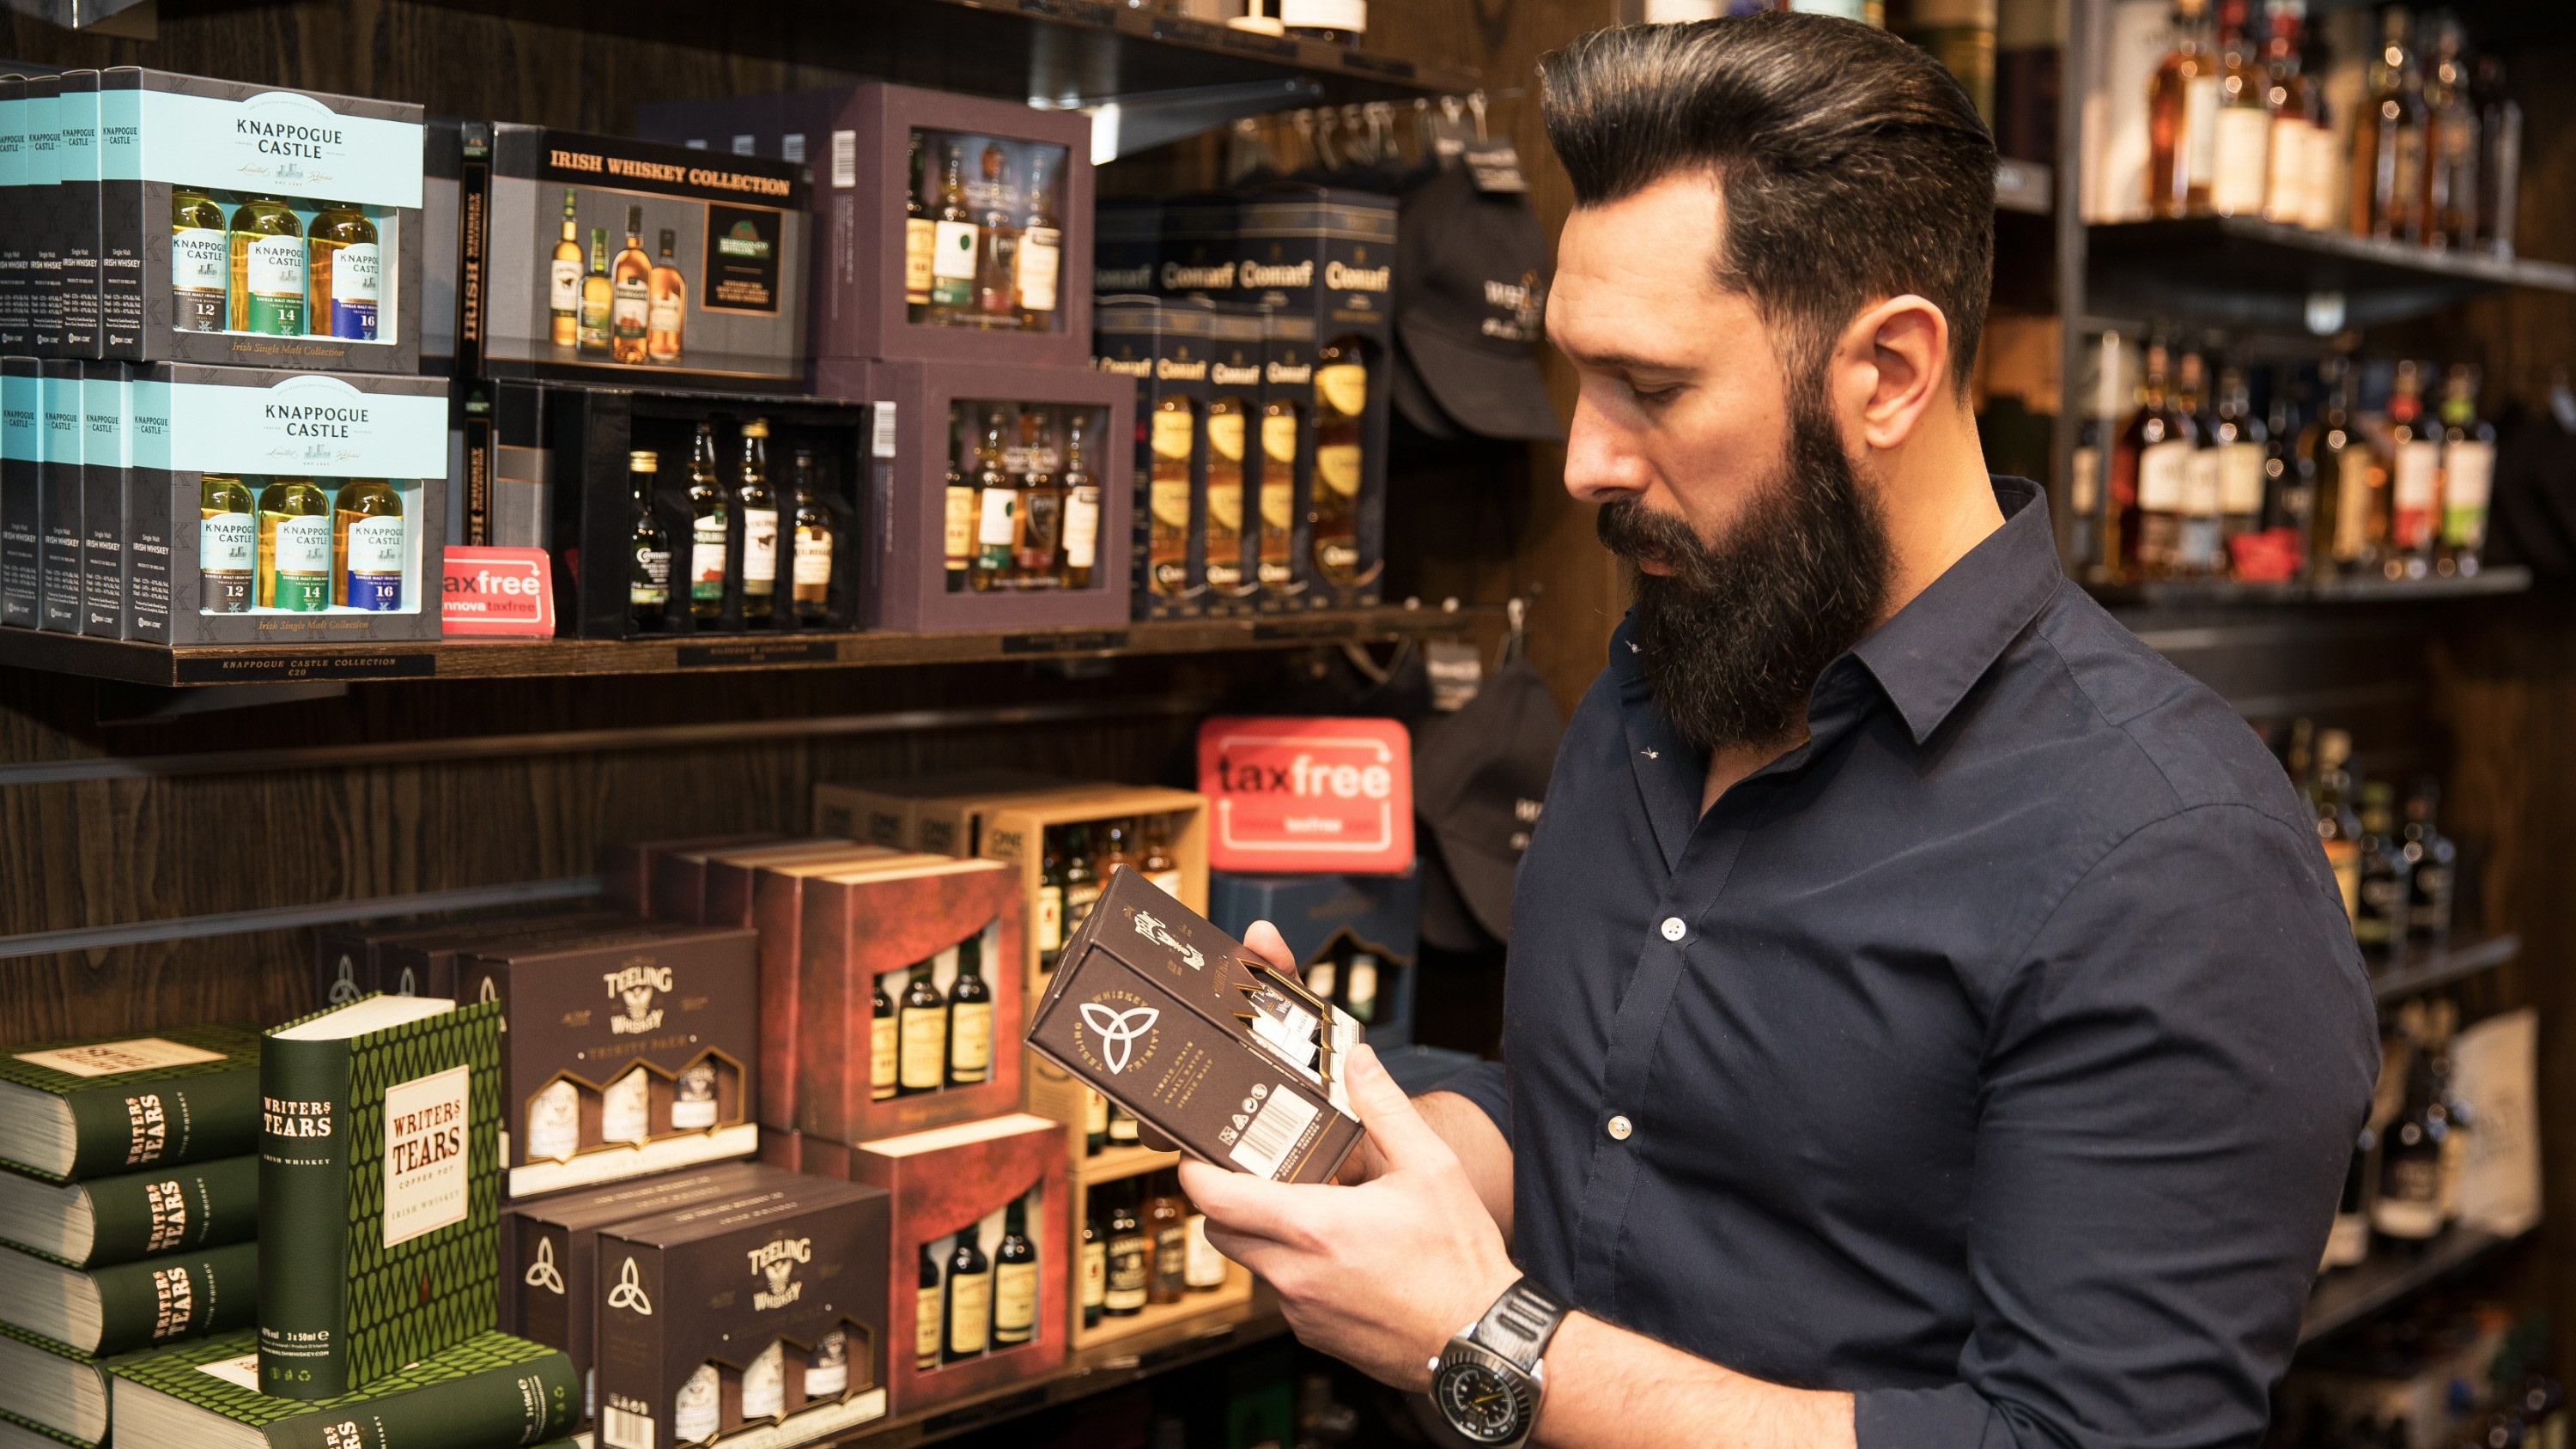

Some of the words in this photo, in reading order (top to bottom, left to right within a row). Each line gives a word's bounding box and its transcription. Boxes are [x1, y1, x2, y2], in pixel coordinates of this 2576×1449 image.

[29, 133, 60, 142] KNAPPOGUE
[63, 129, 94, 137] KNAPPOGUE
[103, 127, 137, 136] KNAPPOGUE
[237, 118, 343, 144] KNAPPOGUE
[69, 137, 88, 146] CASTLE
[109, 136, 131, 144] CASTLE
[258, 139, 322, 160] CASTLE
[550, 149, 604, 173] IRISH
[606, 157, 688, 184] WHISKEY
[689, 167, 791, 197] COLLECTION
[466, 192, 476, 257] WHISKEY
[112, 248, 122, 257] Single
[187, 250, 222, 261] CASTLE
[8, 261, 28, 270] WHISKEY
[30, 260, 43, 269] IRISH
[43, 261, 62, 270] WHISKE
[63, 258, 76, 266] IRISH
[118, 259, 140, 268] WHISKEY
[269, 257, 301, 267] CASTLE
[353, 264, 378, 273] CASTL
[464, 260, 479, 341] IRISH
[196, 303, 215, 316] 12
[278, 309, 295, 320] 14
[361, 315, 375, 326] 16
[232, 341, 252, 353] Irish
[254, 343, 279, 356] Single
[282, 345, 301, 355] Malt
[303, 345, 344, 357] Collection
[3, 409, 34, 420] KNAPPOGUE
[46, 412, 77, 422] KNAPPOGUE
[265, 404, 368, 422] KNAPPOGUE
[9, 419, 28, 427] CASTLE
[52, 421, 70, 430] CASTLE
[87, 415, 118, 425] KNAPPOGUE
[134, 415, 167, 427] KNAPPOGUE
[92, 423, 112, 433] CASTLE
[141, 425, 161, 434] CASTLE
[286, 422, 349, 439] CASTLE
[205, 523, 254, 535] KNAPPOGU
[15, 533, 36, 543] WHISKEY
[45, 535, 58, 544] IRISH
[58, 537, 79, 548] WHISKEY
[219, 534, 252, 543] CASTLE
[296, 536, 327, 545] CASTLE
[368, 536, 400, 545] CASTLE
[86, 539, 98, 548] IRISH
[99, 541, 120, 551] WHISKEY
[133, 542, 146, 551] IRISH
[146, 544, 169, 555] WHISKEY
[443, 570, 540, 596] axfree
[226, 585, 244, 597] 12
[303, 586, 320, 597] 14
[376, 585, 393, 597] 16
[443, 602, 486, 611] nnova
[258, 620, 277, 630] Irish
[280, 621, 305, 633] Single
[307, 621, 327, 630] Malt
[329, 621, 368, 630] Collection
[222, 659, 284, 670] KNAPPOGUE
[291, 658, 329, 668] CASTLE
[334, 658, 396, 667] COLLECTION
[289, 668, 307, 676] €20
[1218, 755, 1391, 798] taxfree
[603, 966, 673, 999] TEELING
[1091, 990, 1149, 1007] WHISKEY
[611, 1008, 664, 1034] WHISKEY
[587, 1040, 647, 1061] TRINITY
[1074, 1022, 1103, 1071] TEELING
[1127, 1028, 1159, 1072] TRINITY
[1152, 1067, 1176, 1098] SINGLE
[1177, 1081, 1199, 1109] SINGLE
[1196, 1058, 1213, 1080] MALT
[1164, 1078, 1185, 1105] SMALL
[264, 1096, 331, 1115] WRITERS
[264, 1113, 331, 1137] TEARS
[392, 1099, 461, 1140] WRITERS
[125, 1096, 146, 1165] WRITERS
[140, 1094, 166, 1164] TEARS
[392, 1125, 460, 1177] TEARS
[264, 1154, 282, 1164] IRISH
[284, 1157, 331, 1167] WHISKEY
[398, 1173, 434, 1191] COPPER
[437, 1164, 455, 1176] POT
[391, 1202, 417, 1221] IRISH
[421, 1189, 460, 1211] WHISKEY
[145, 1183, 167, 1252] WRITERS
[160, 1180, 187, 1250] TEARS
[747, 1237, 811, 1276] TEELING
[167, 1266, 193, 1337] TEARS
[753, 1282, 803, 1312] WHISKEY
[152, 1270, 173, 1340] WRITERS
[298, 1332, 316, 1342] 50ml
[373, 1416, 388, 1449] HISKEY
